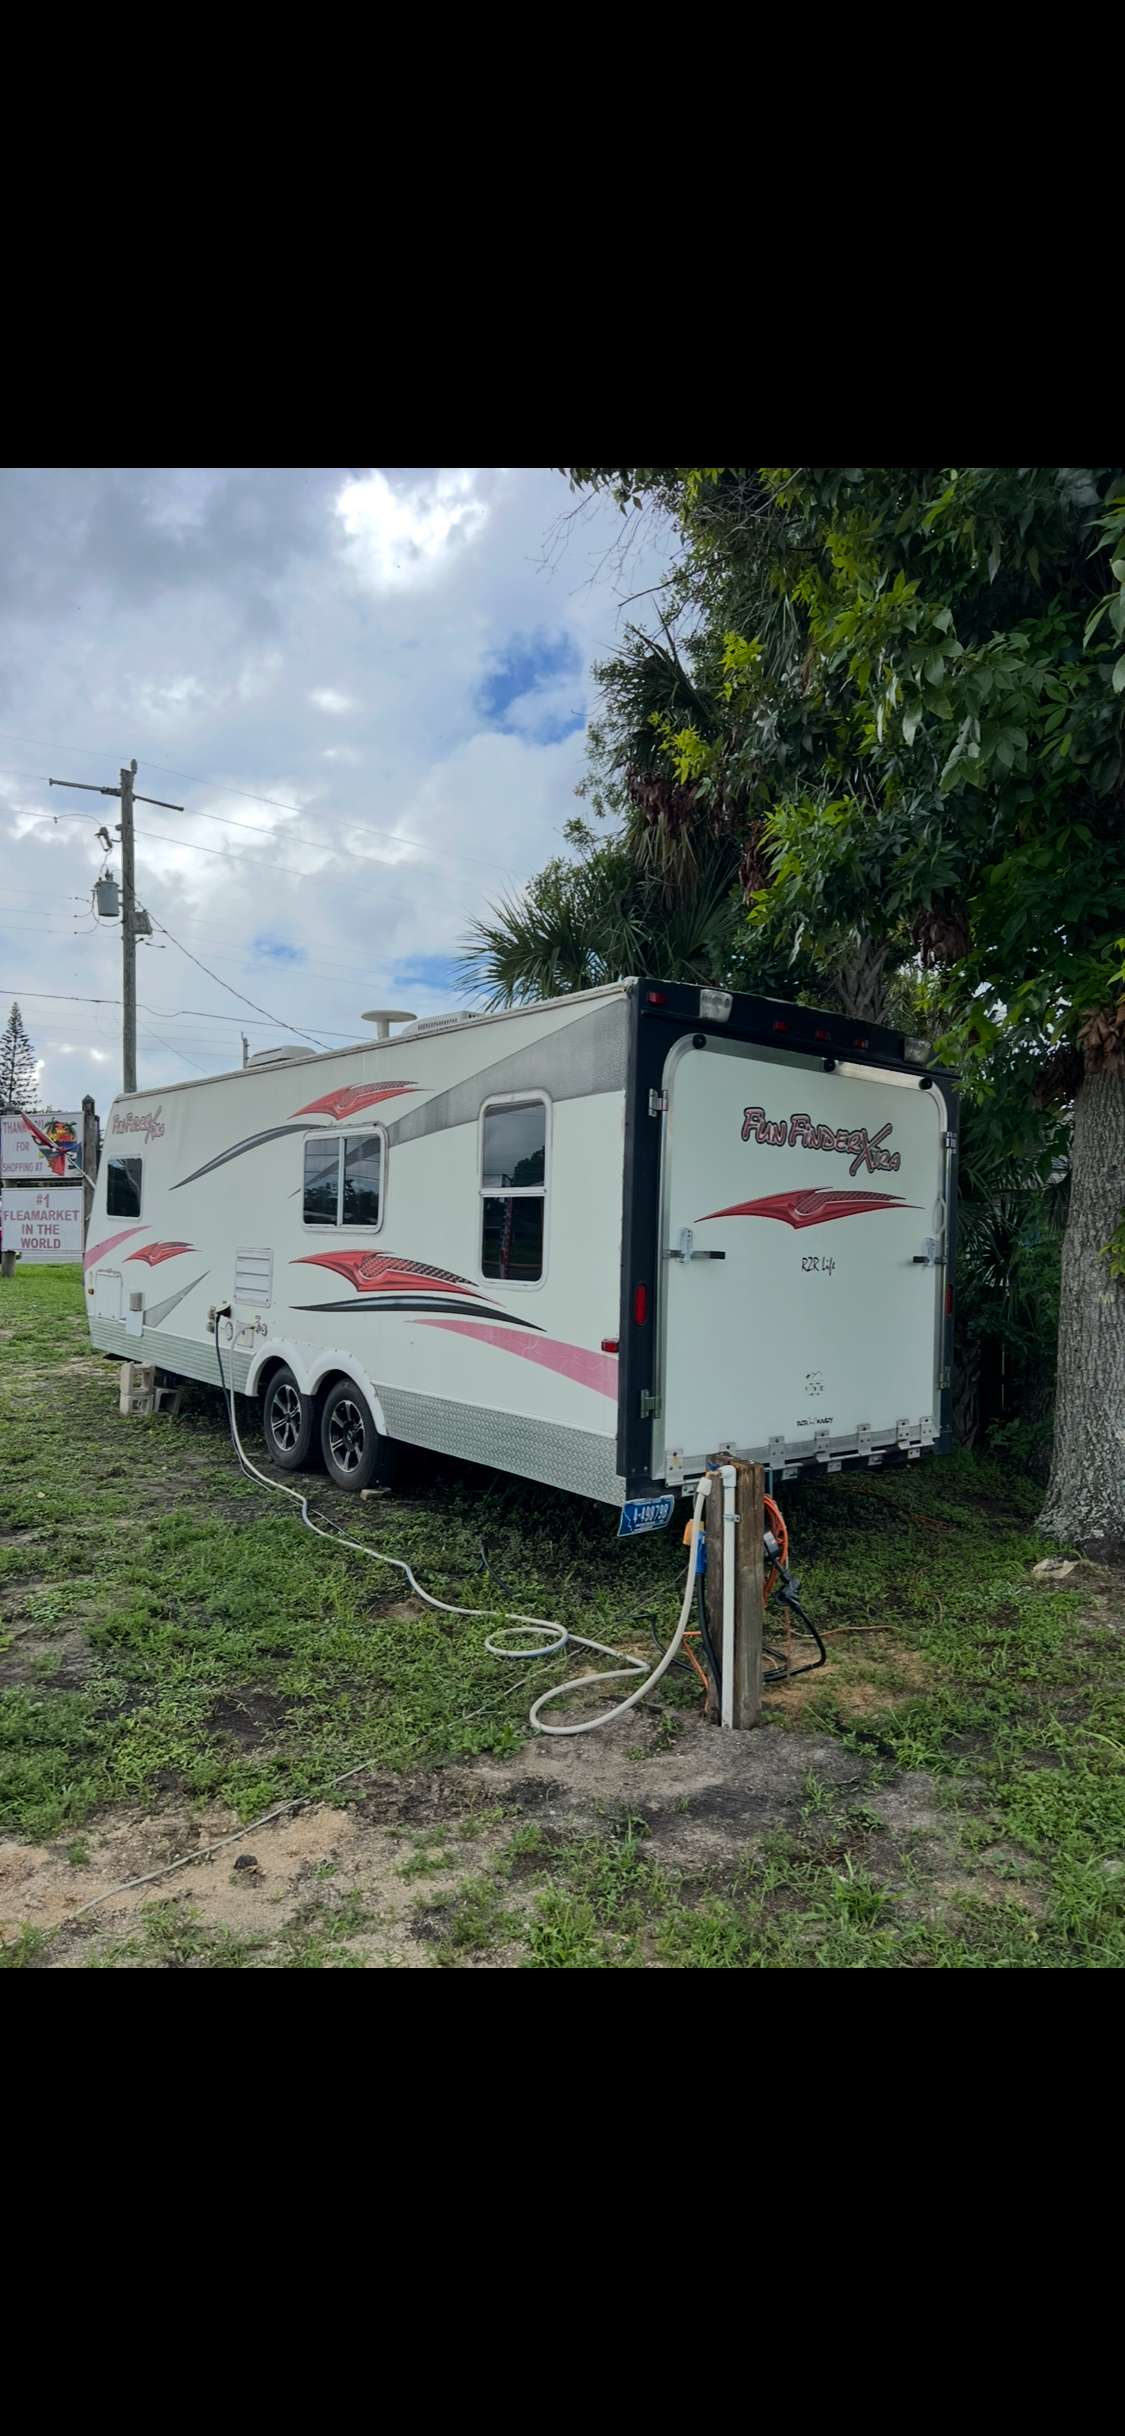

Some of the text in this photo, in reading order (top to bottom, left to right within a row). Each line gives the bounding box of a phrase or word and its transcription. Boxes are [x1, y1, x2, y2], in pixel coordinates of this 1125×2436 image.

[16, 1141, 30, 1152] FOR
[1, 1161, 33, 1172] SHOPPING
[36, 1193, 49, 1208] #1
[3, 1209, 80, 1221] FLEAMARKET
[21, 1224, 61, 1235] IN THE
[20, 1238, 61, 1249] WORLD
